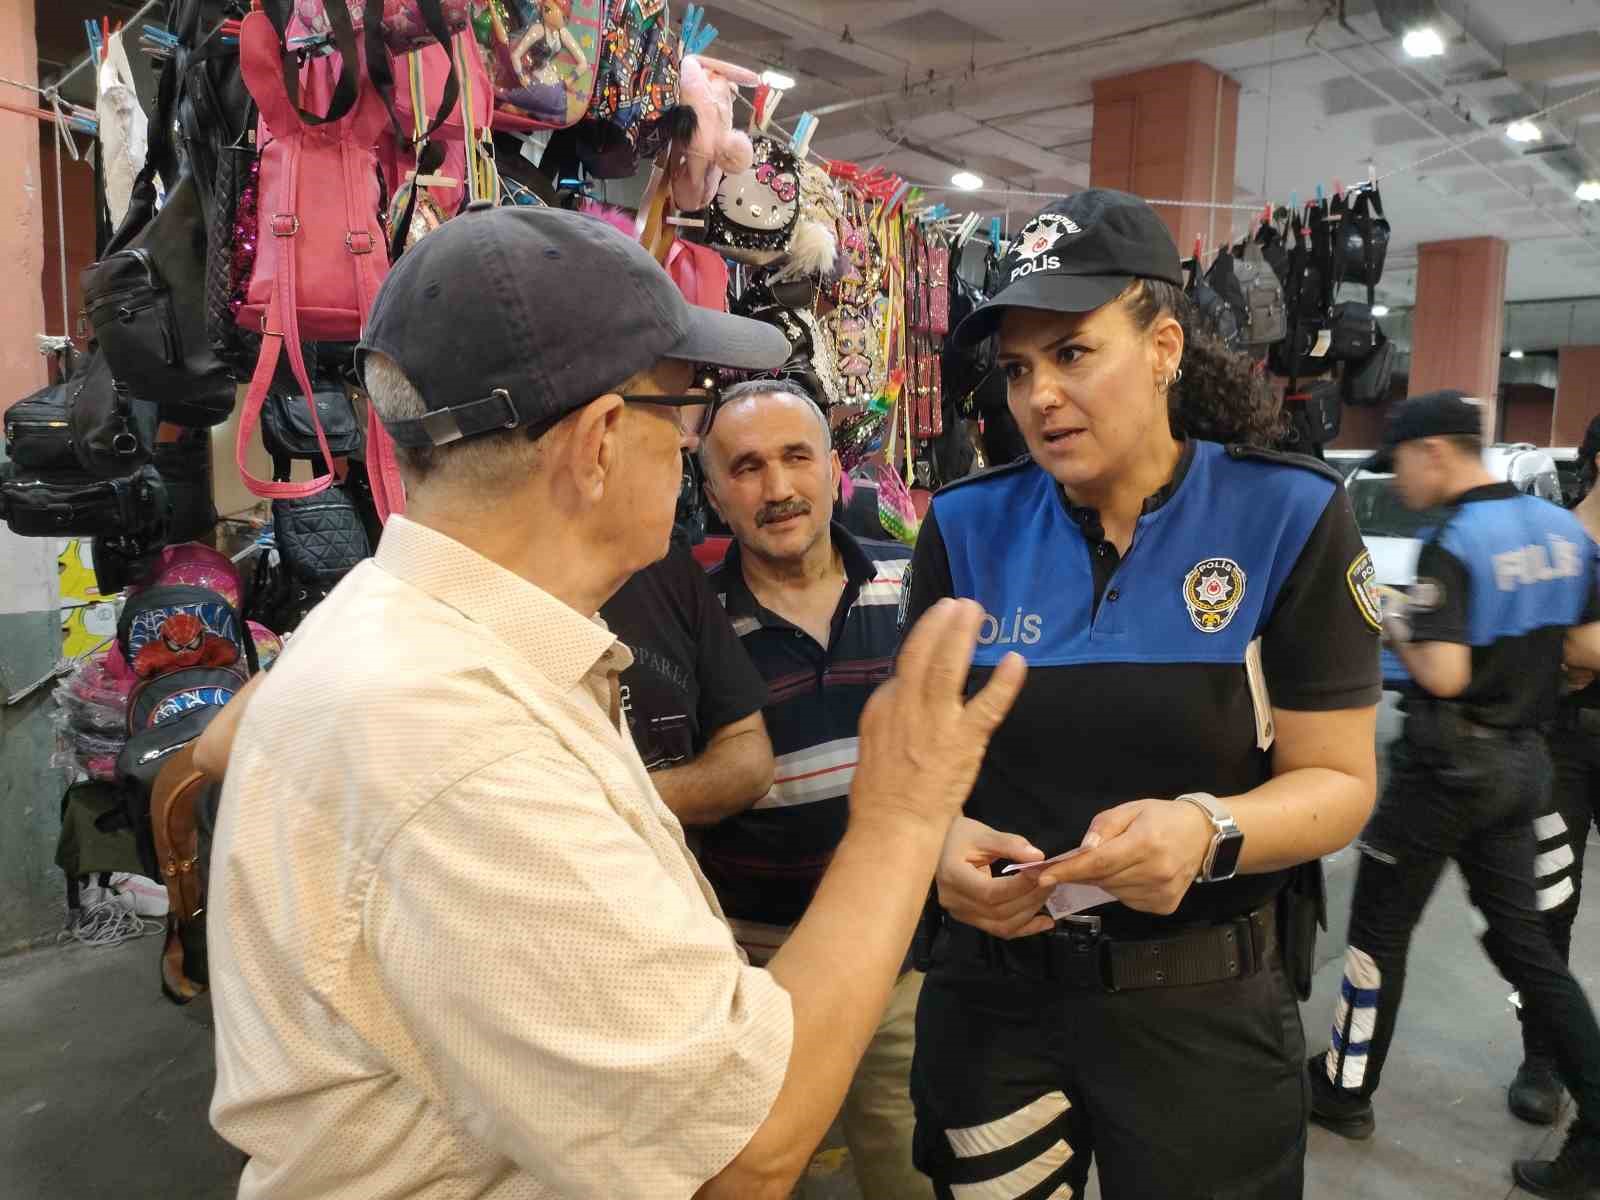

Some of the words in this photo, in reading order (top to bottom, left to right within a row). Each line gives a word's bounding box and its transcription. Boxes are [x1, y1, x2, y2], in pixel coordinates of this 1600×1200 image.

[1010, 255, 1062, 283] POLİS
[1198, 560, 1233, 573] POLİS
[976, 606, 1042, 645] OLİS
